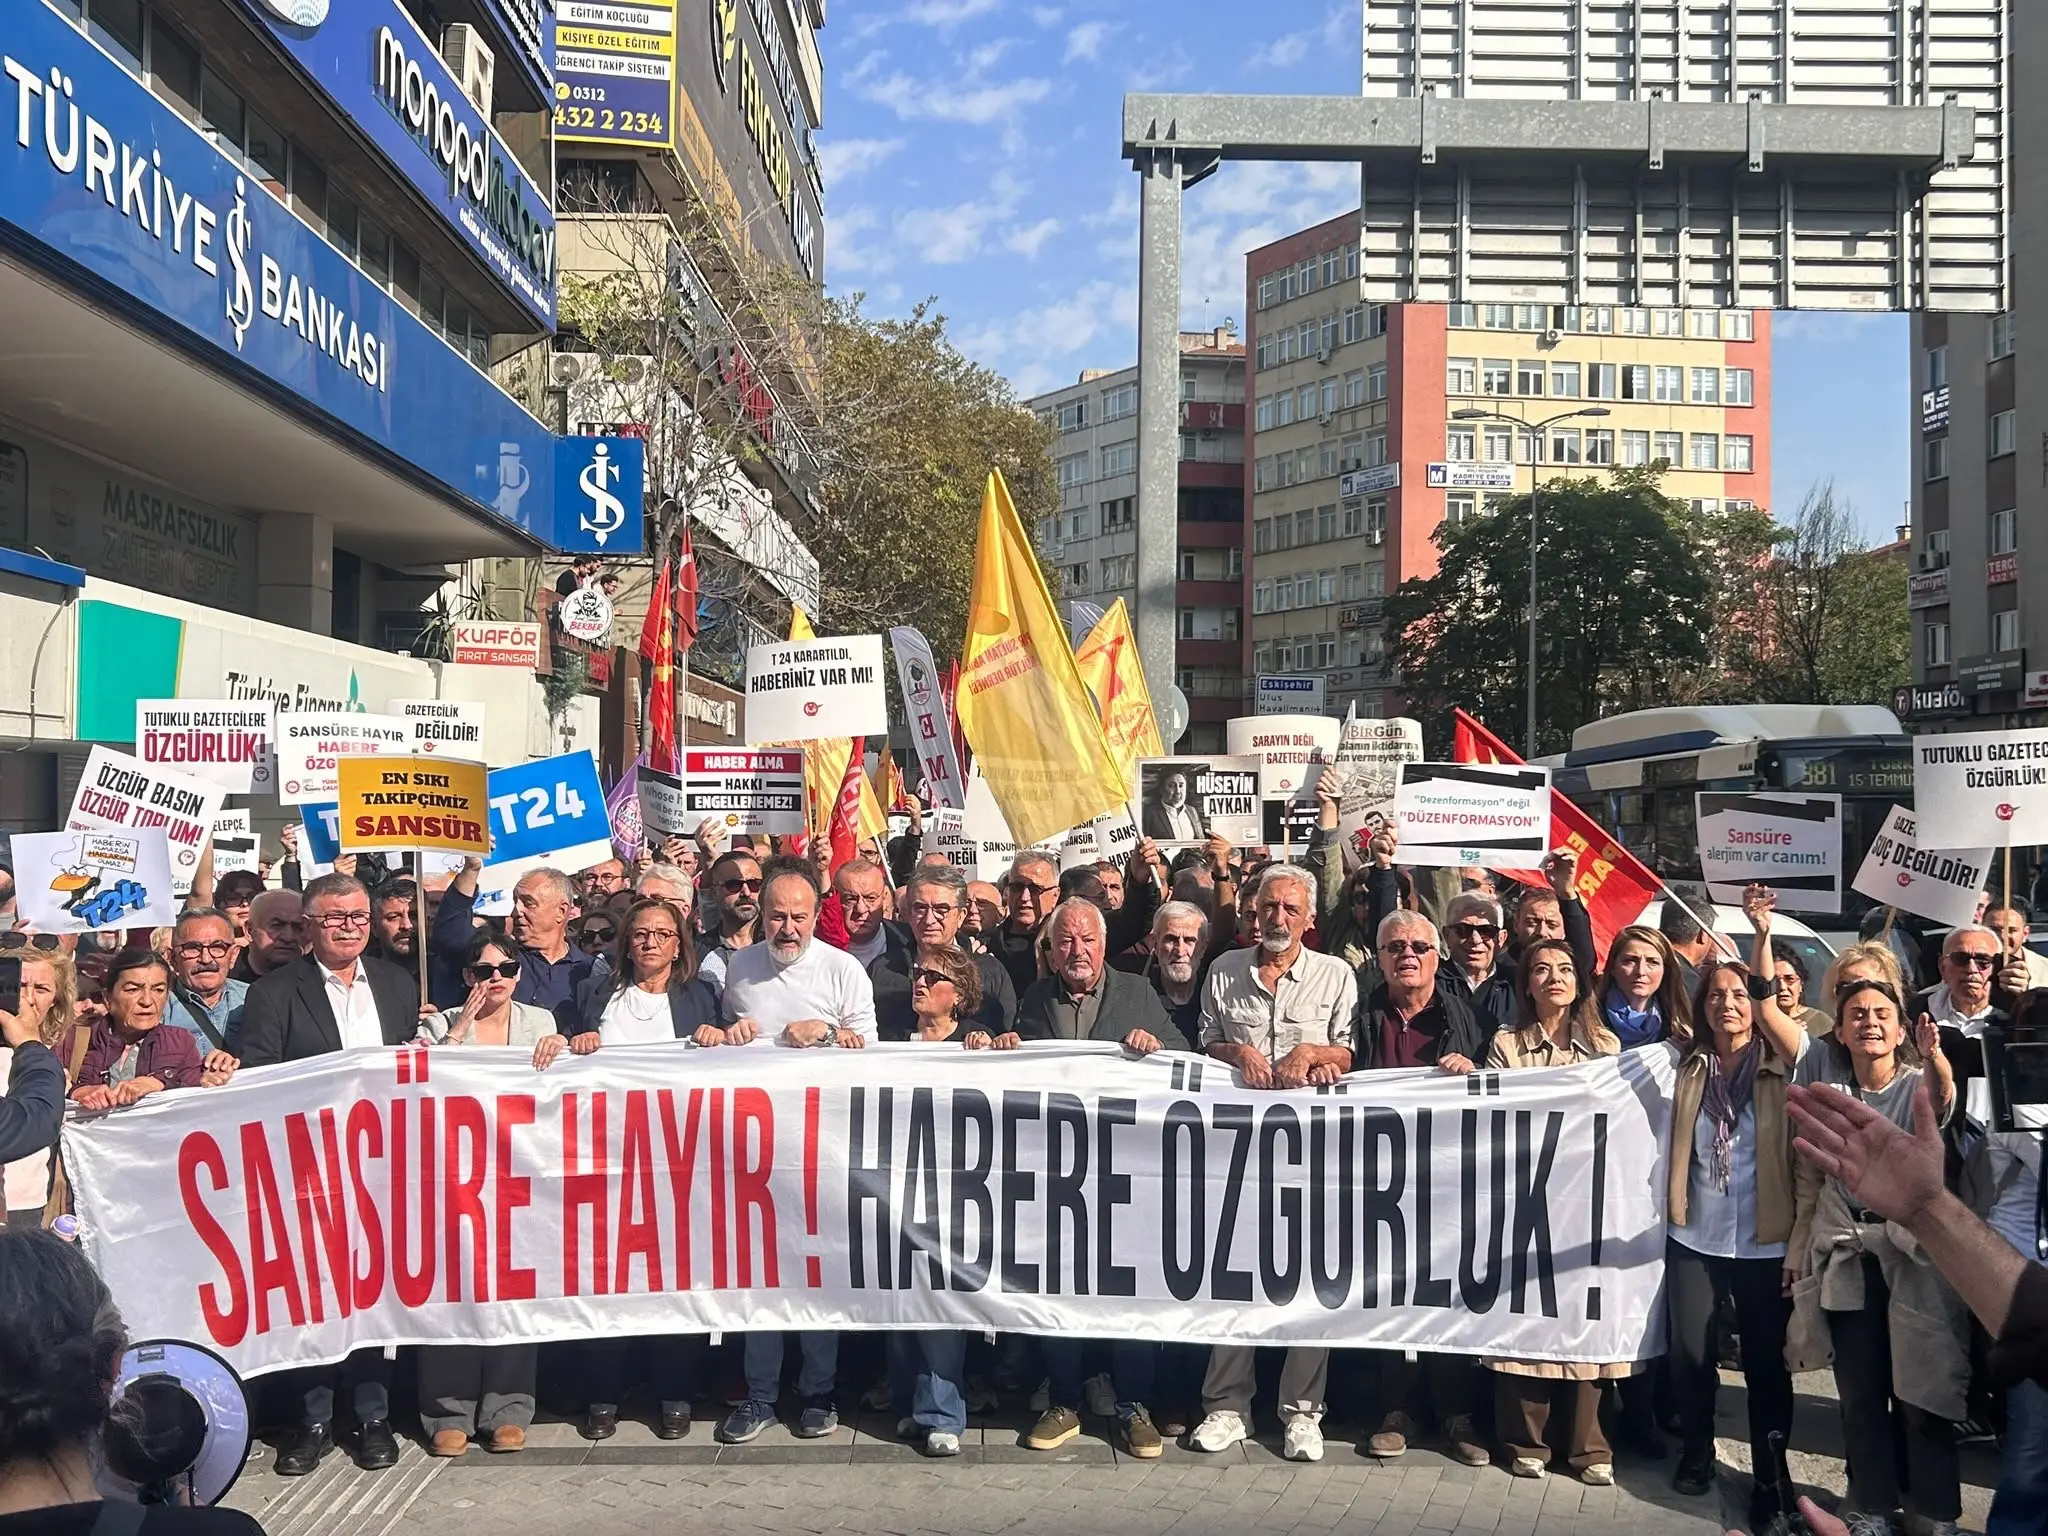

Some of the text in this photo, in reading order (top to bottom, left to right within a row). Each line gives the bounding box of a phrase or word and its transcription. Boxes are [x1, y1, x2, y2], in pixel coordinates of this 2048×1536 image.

[571, 7, 649, 24] EĞİTİM KOÇLUĞU
[562, 31, 660, 51] KİŞİYE ÖZEL EĞİTİM
[598, 59, 624, 71] TAKİP
[627, 62, 665, 76] SİSTEMİ
[573, 86, 605, 101] 0312
[554, 104, 663, 135] 432 2 234
[4, 55, 217, 277] TÜRKİYE
[261, 253, 386, 394] BANKASI
[793, 182, 815, 280] KURS
[103, 480, 238, 560] MASRAFSIZLIK
[101, 524, 175, 585] ZATEN
[569, 621, 604, 631] BERBER
[456, 627, 537, 646] KUAFÖR
[457, 651, 535, 664] FIRAT SANSAR
[779, 652, 791, 665] 24
[793, 648, 852, 663] KARARTILDI,
[751, 666, 874, 693] HABERİNİZ VAR MI!
[1262, 680, 1312, 690] Eskişehir
[226, 671, 290, 719] Türkiye
[1260, 694, 1283, 702] Ulus
[144, 710, 266, 727] TUTUKLU GAZETECİLERE
[405, 704, 459, 718] GAZETECİLİK
[289, 723, 404, 742] SANSÜRE HAYIR
[415, 719, 479, 742] DEĞİLDİR!
[1253, 733, 1316, 747] SARAYIN DEĞİL
[144, 729, 266, 762] ÖZGÜRLÜK!
[318, 741, 380, 753] HABERE
[1921, 745, 1982, 764] TUTUKLU
[704, 756, 784, 770] HABER ALMA
[381, 773, 450, 789] EN SIKI
[725, 778, 762, 791] HAKKI
[1196, 772, 1255, 794] HÜSEYİN
[1869, 774, 1914, 787] TEMMU
[1965, 765, 2046, 788] ÖZGÜRLÜK!
[97, 761, 205, 818] ÖZGÜR BASIN
[644, 784, 675, 803] Whose
[79, 786, 130, 824] ÖZGÜR
[361, 790, 470, 811] TAKİPÇİMİZ
[490, 781, 587, 835] T24
[663, 804, 673, 815] be
[695, 795, 793, 809] ENGELLENEMEZ!
[1208, 795, 1252, 815] AYKAN
[1414, 794, 1530, 810] "Dezenformasyon" değil
[355, 814, 484, 844] SANSÜR
[1399, 811, 1540, 828] "DÜZENFORMASYON"
[1727, 828, 1792, 846] Sansüre
[1460, 849, 1480, 861] tgs
[1706, 847, 1827, 865] alerjim var canım!
[1871, 835, 1893, 866] SUÇ
[224, 855, 245, 866] gün
[70, 879, 147, 928] T24
[178, 1048, 1608, 1348] SANSÜRE HAYIR ! HABERE ÖZGÜRLÜK !
